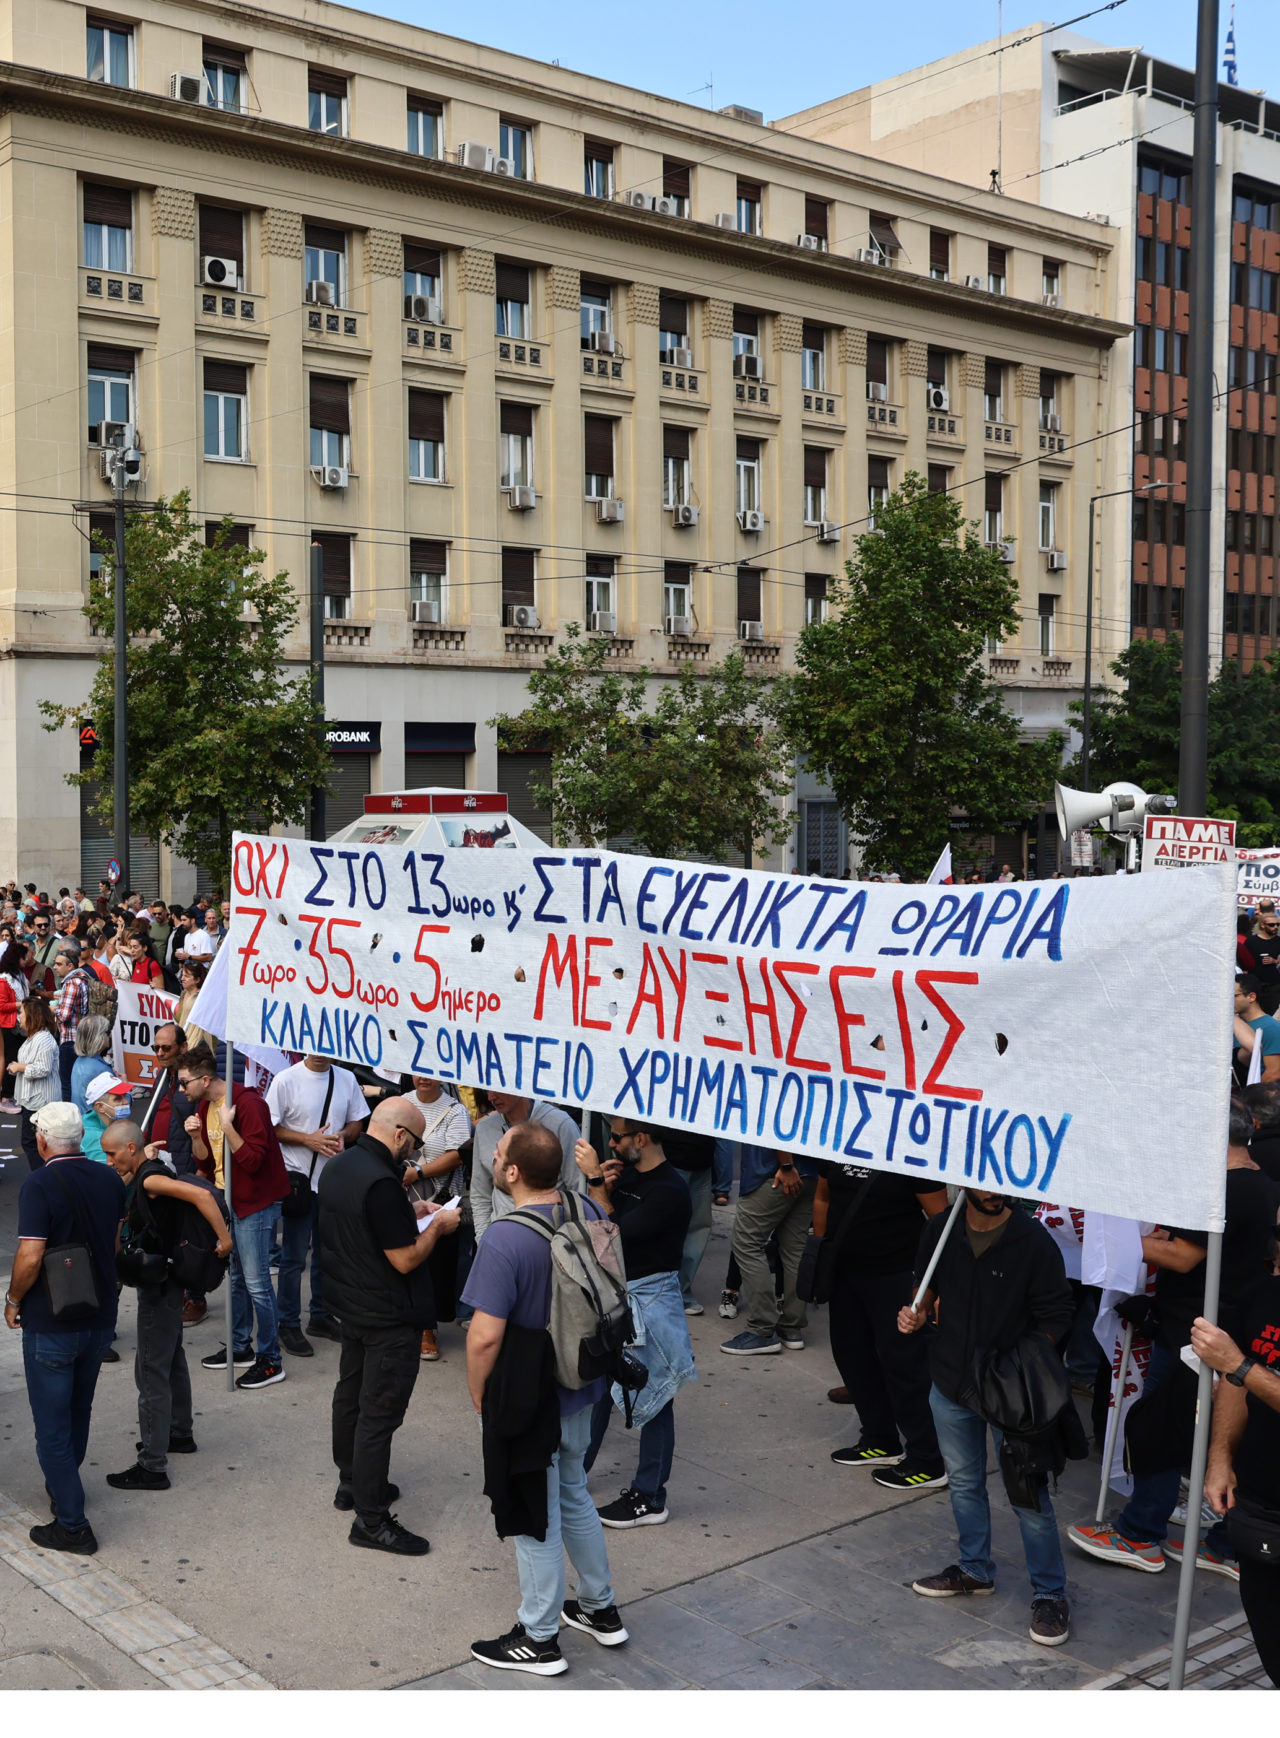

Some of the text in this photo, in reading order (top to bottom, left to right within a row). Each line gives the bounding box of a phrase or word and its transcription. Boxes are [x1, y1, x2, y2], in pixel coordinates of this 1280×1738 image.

[325, 731, 370, 742] ROBANK
[1152, 820, 1230, 844] ΠΑΜΕ
[233, 840, 289, 900] ΟΧΙ
[304, 847, 387, 911] ΣΤΟ
[408, 851, 495, 921] 13ωρο
[533, 856, 627, 926] ΣΤΑ
[636, 865, 868, 953] ΕΥΕΛΙΚΤΑ
[878, 884, 1071, 962] ΩΡΑΡΙΑ
[120, 1020, 150, 1047] ΣΤΟ
[533, 932, 615, 1032] ΜΕ
[626, 940, 984, 1102] ΑΥΞΗΣΕΙΣ
[261, 997, 1073, 1193] ΚΛΑΔΙΚΟ ΣΩΜΑΤΕΙΟ ΧΡΗΜΑΤΟΠΙΣΤΩΤΙΚΟΥ
